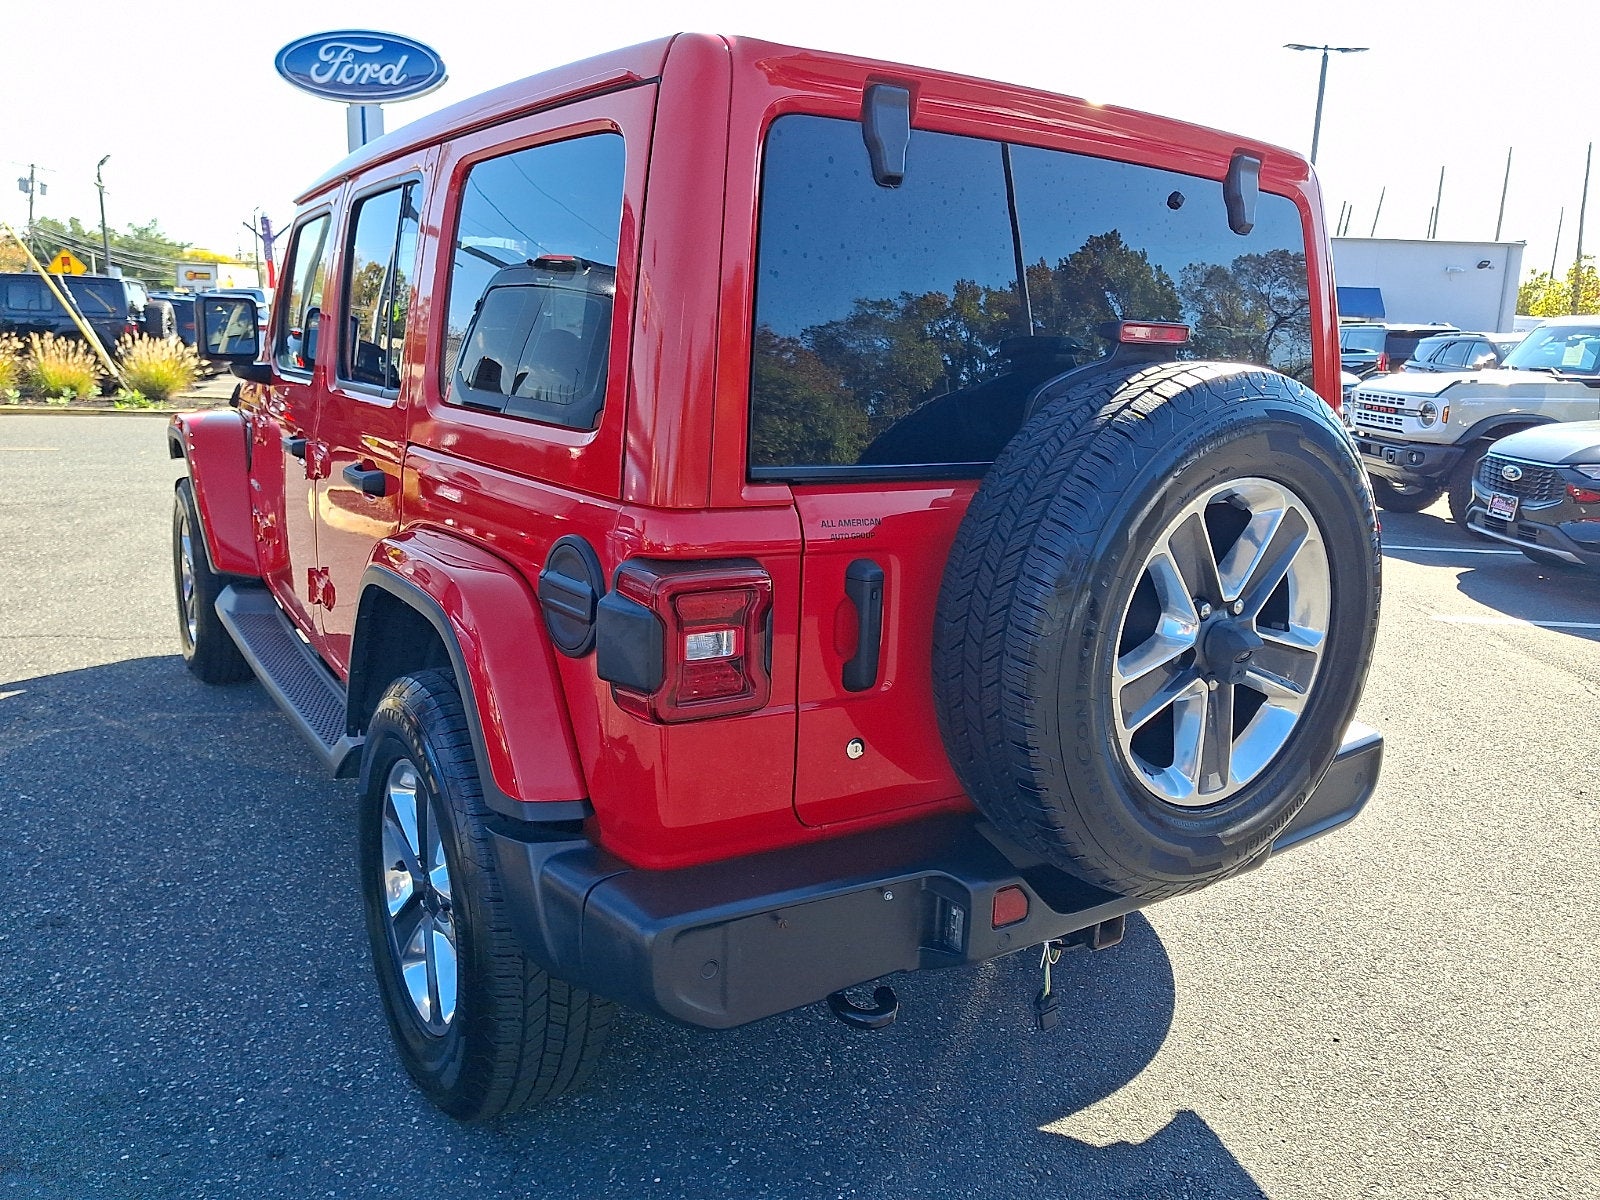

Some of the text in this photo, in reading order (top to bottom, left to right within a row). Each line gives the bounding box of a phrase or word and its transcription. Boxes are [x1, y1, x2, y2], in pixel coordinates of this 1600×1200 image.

[310, 42, 409, 86] Ford
[820, 517, 882, 528] ALL AMERICAN
[850, 531, 876, 539] GROUP
